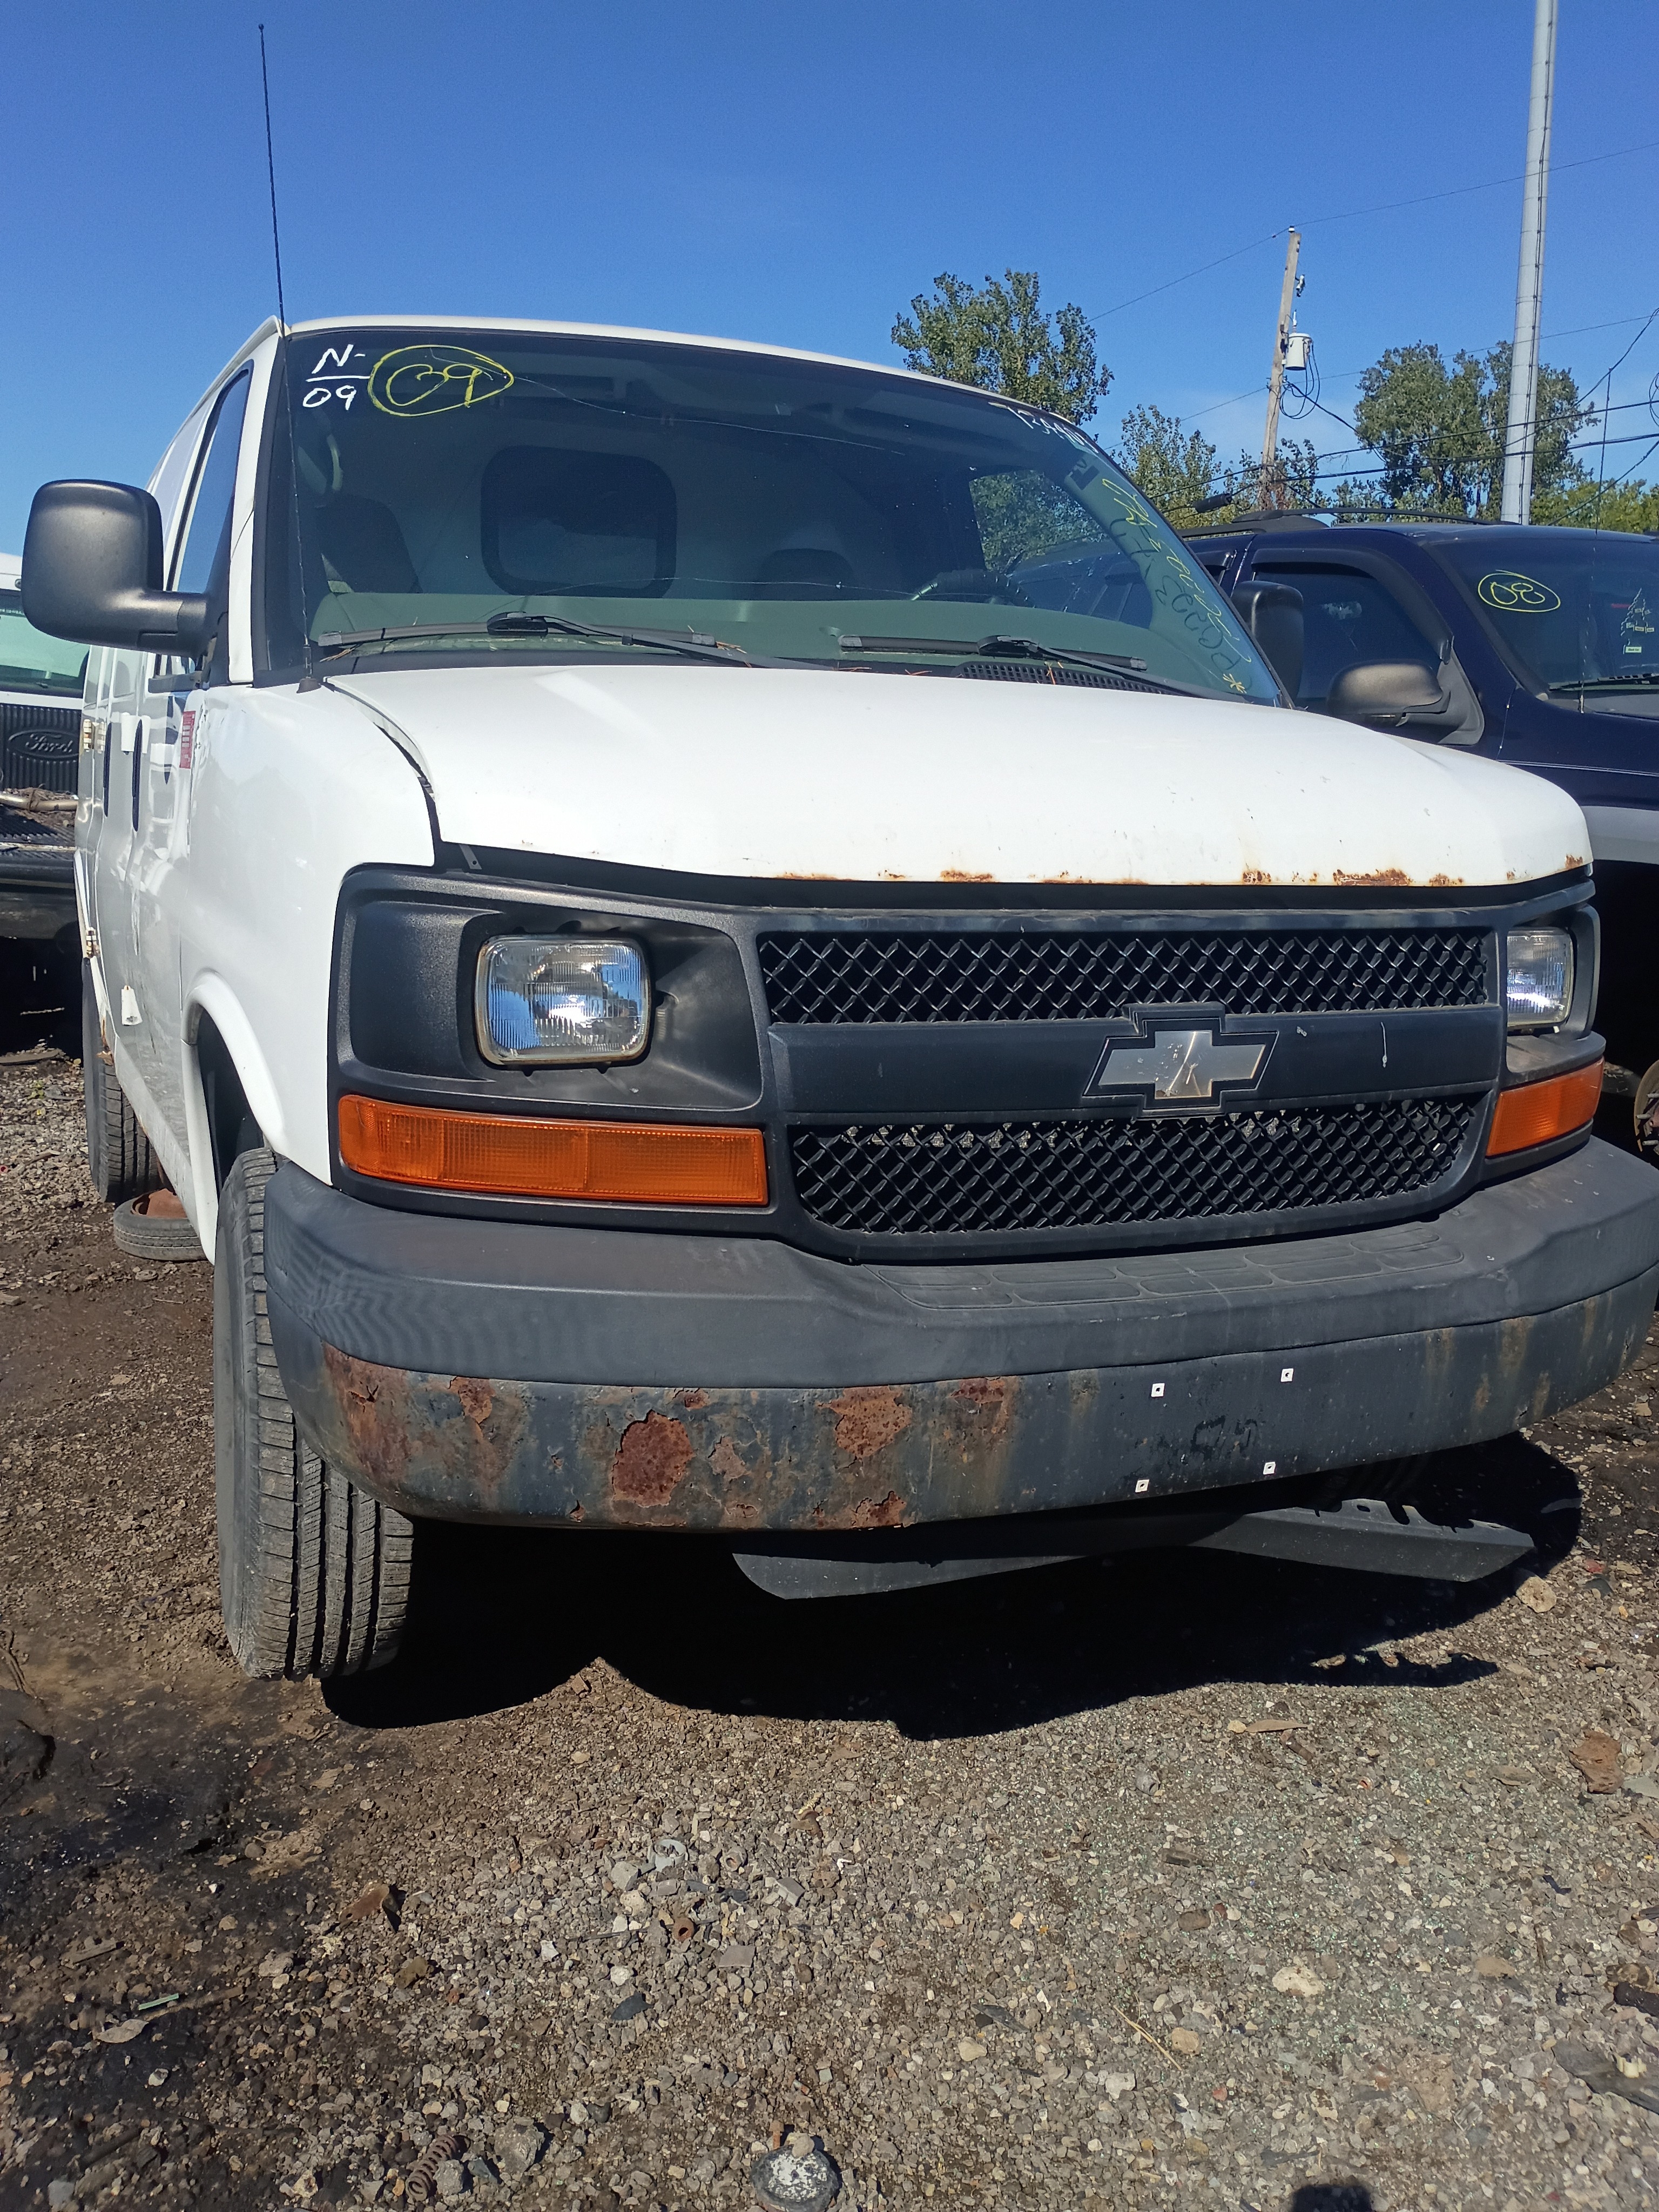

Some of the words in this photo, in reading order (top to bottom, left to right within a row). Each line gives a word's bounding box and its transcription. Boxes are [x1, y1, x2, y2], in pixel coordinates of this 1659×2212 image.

[302, 385, 357, 410] 09
[1491, 582, 1546, 605] 08
[25, 733, 73, 753] Ford
